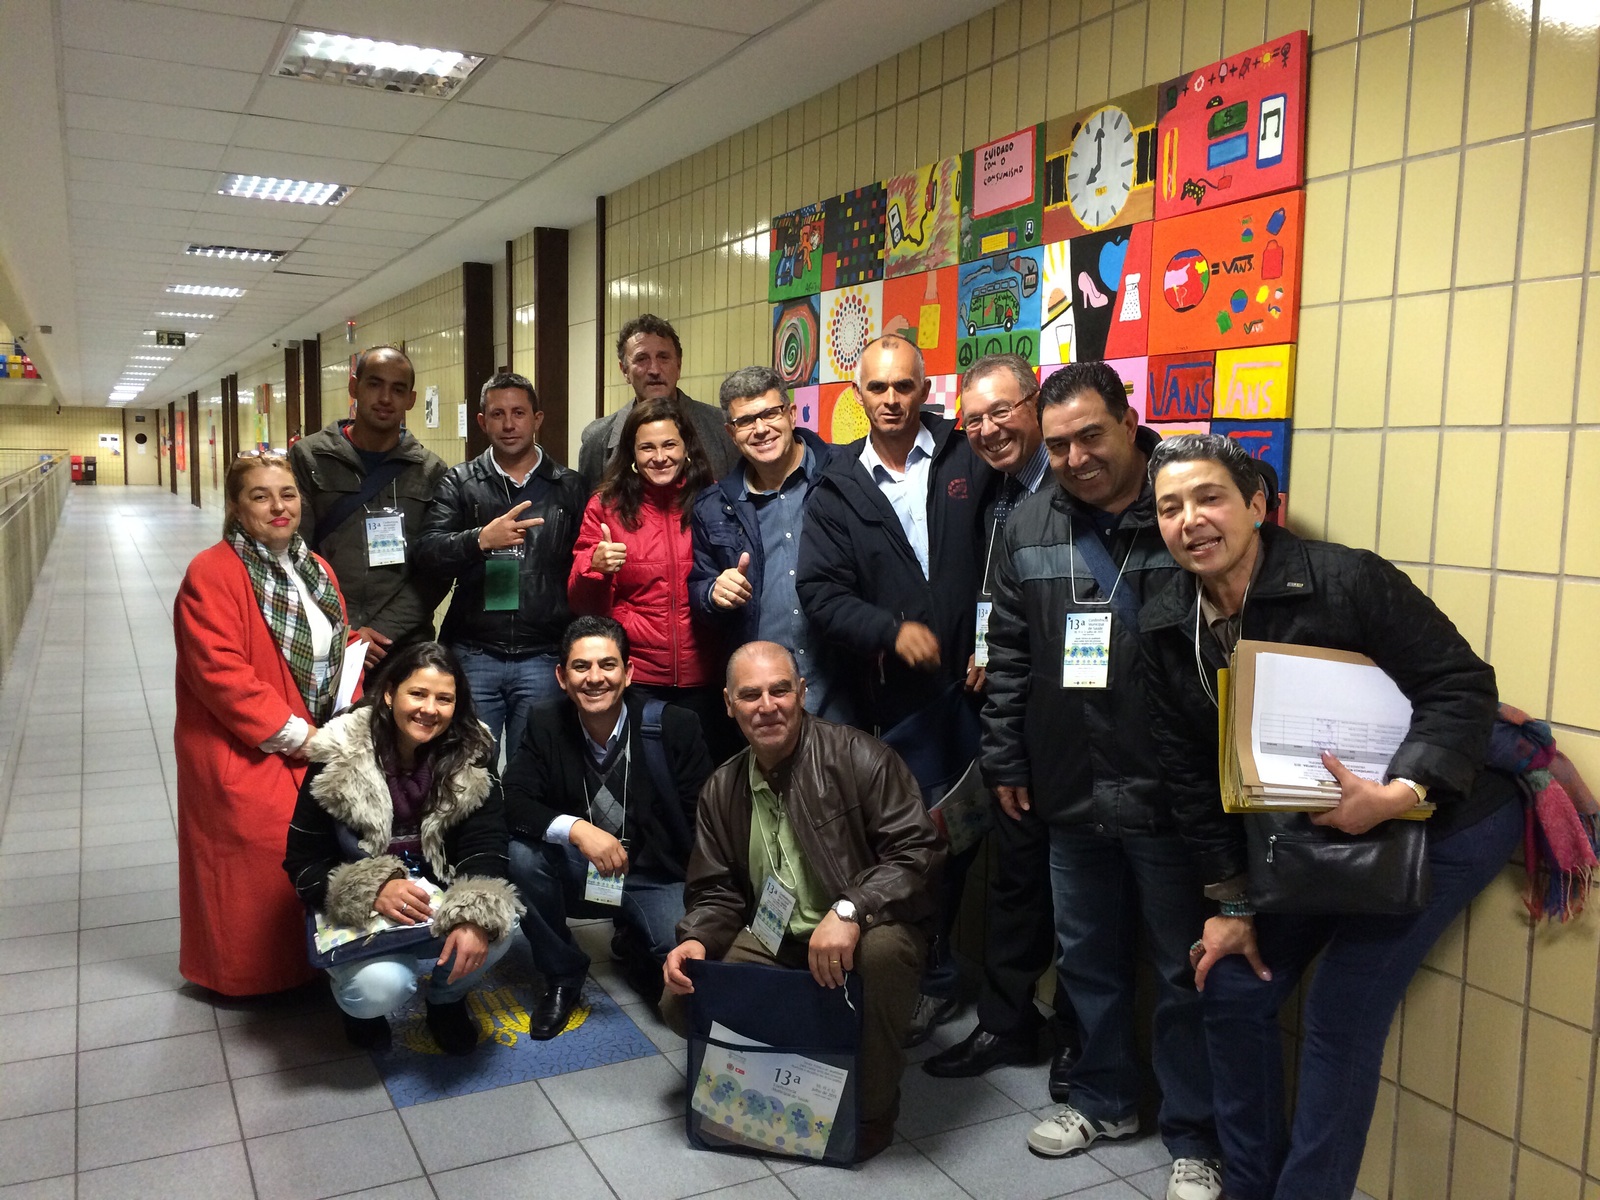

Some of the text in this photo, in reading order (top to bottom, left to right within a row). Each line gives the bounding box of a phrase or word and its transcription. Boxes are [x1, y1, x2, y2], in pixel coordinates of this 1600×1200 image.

[984, 142, 1014, 161] CUIDADO
[1000, 157, 1006, 165] O
[984, 165, 1023, 185] CONSUMISMO
[1150, 361, 1213, 416] VANS
[1215, 362, 1281, 416] VANS
